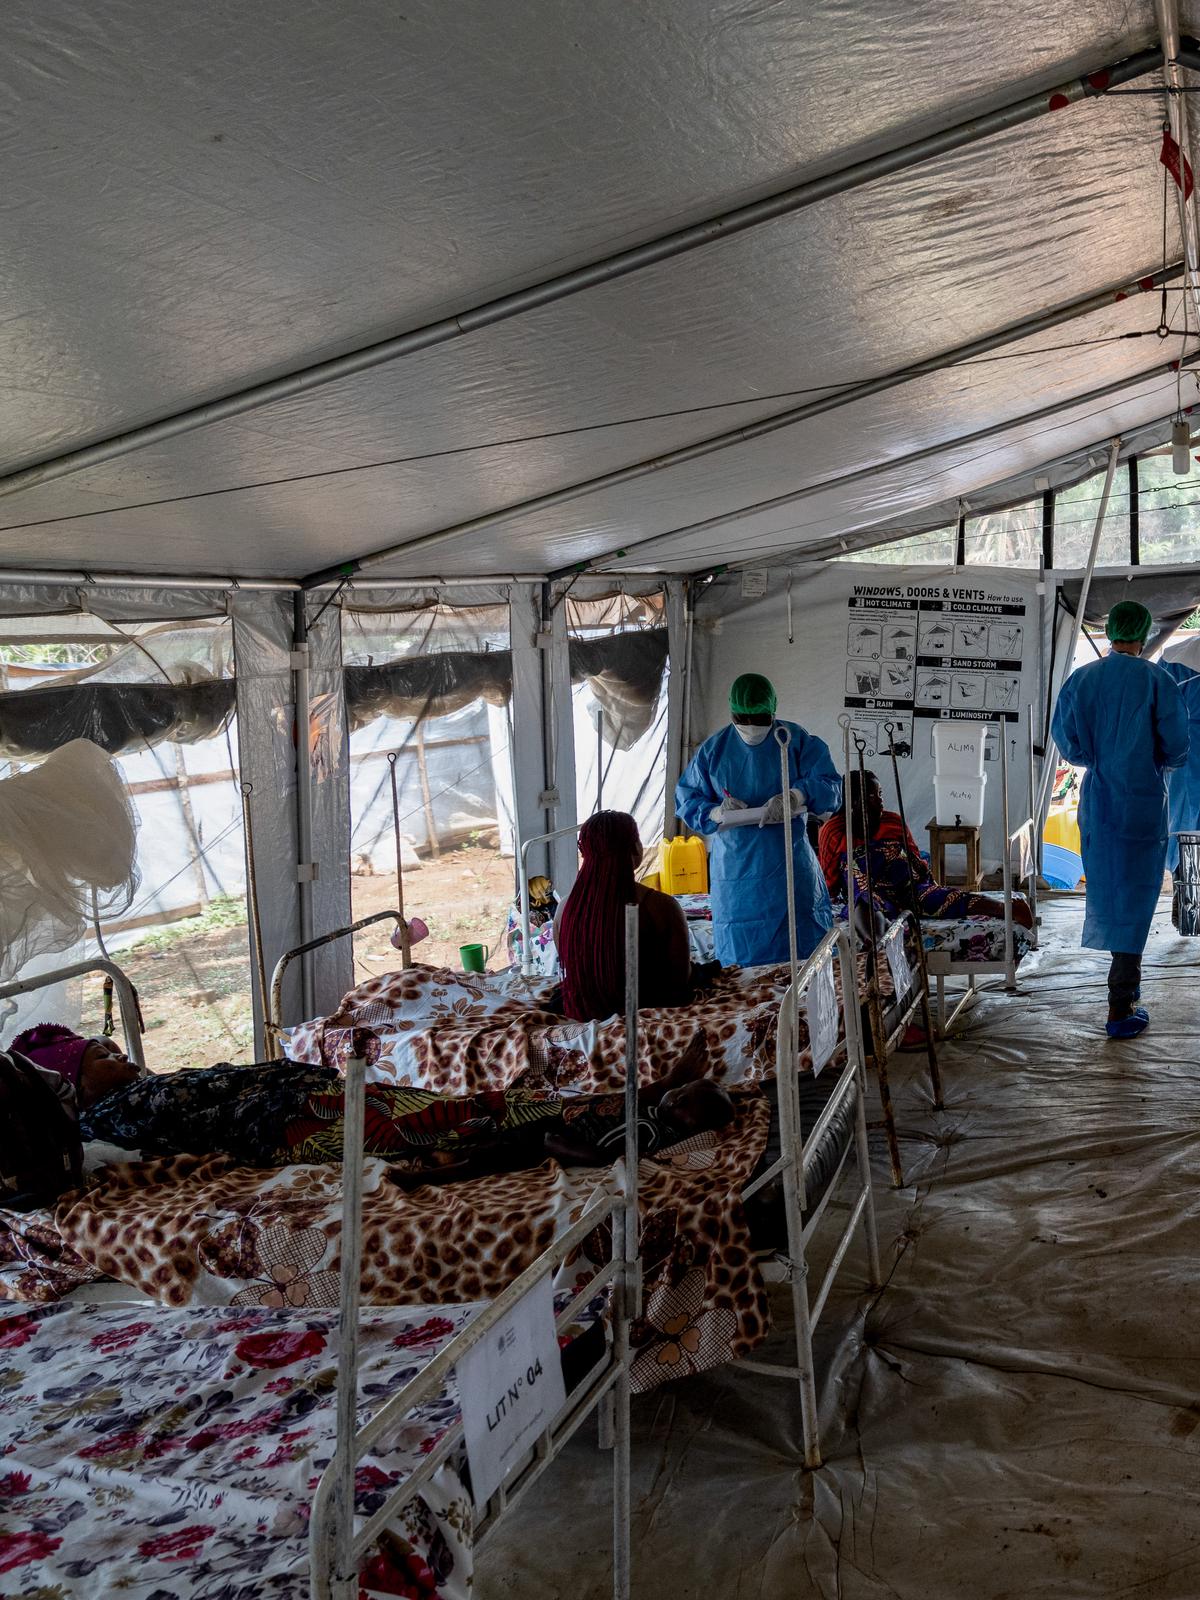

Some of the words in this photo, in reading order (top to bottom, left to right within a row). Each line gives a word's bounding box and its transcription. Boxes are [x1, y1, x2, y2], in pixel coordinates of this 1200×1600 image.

[853, 586, 904, 598] WINDOWS,
[907, 587, 940, 598] DOORS
[942, 589, 950, 598] &
[952, 589, 985, 600] VENTS
[987, 594, 1002, 602] How
[881, 600, 912, 608] CLIMATE
[972, 605, 1003, 613] CLIMATE
[952, 659, 971, 667] SAND
[972, 660, 997, 669] STORM
[876, 700, 894, 708] RAIN
[951, 711, 993, 720] LUMINOSITY
[486, 1396, 507, 1433] LIT
[526, 1356, 543, 1386] 04
